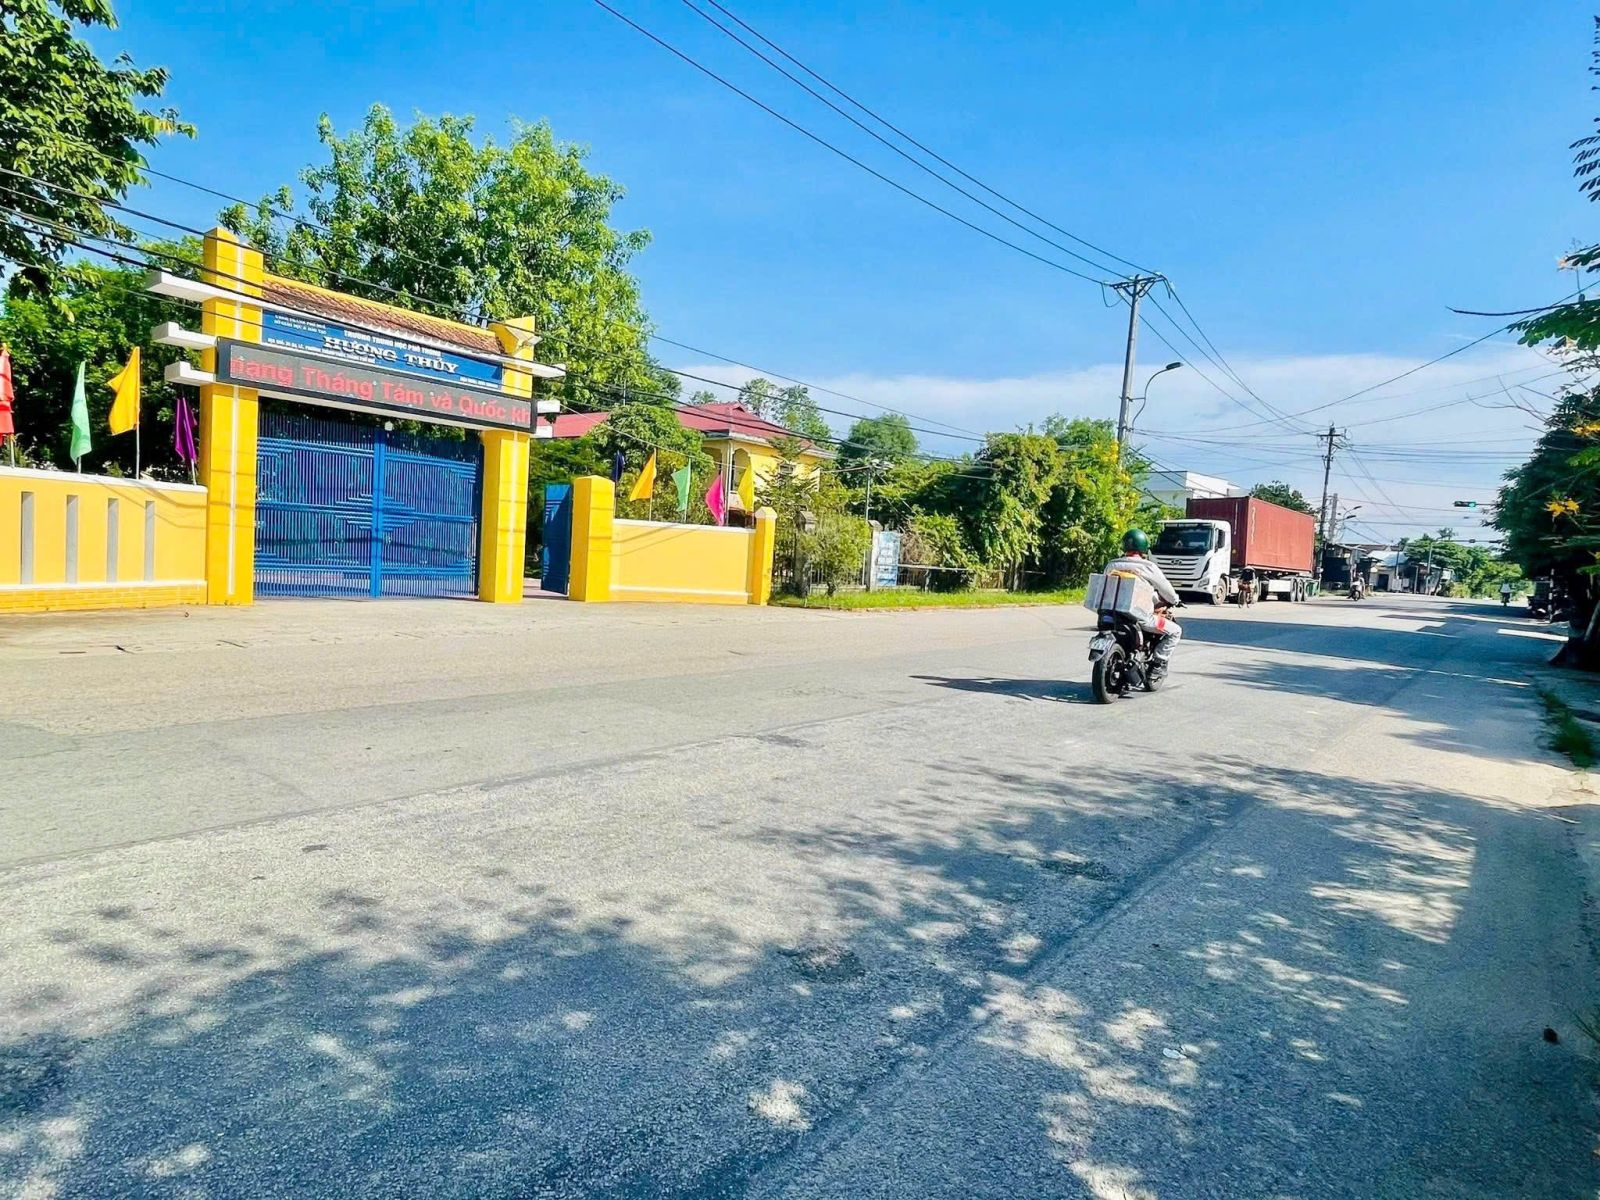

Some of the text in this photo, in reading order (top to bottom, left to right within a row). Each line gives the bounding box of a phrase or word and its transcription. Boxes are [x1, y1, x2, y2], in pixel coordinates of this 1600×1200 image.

[323, 336, 398, 362] HƯƠNG
[373, 335, 394, 347] TRUNG
[395, 341, 408, 350] HỌC
[302, 367, 374, 400] Tháng
[382, 381, 424, 405] Tám
[430, 390, 454, 410] và
[459, 395, 506, 420] Quốc
